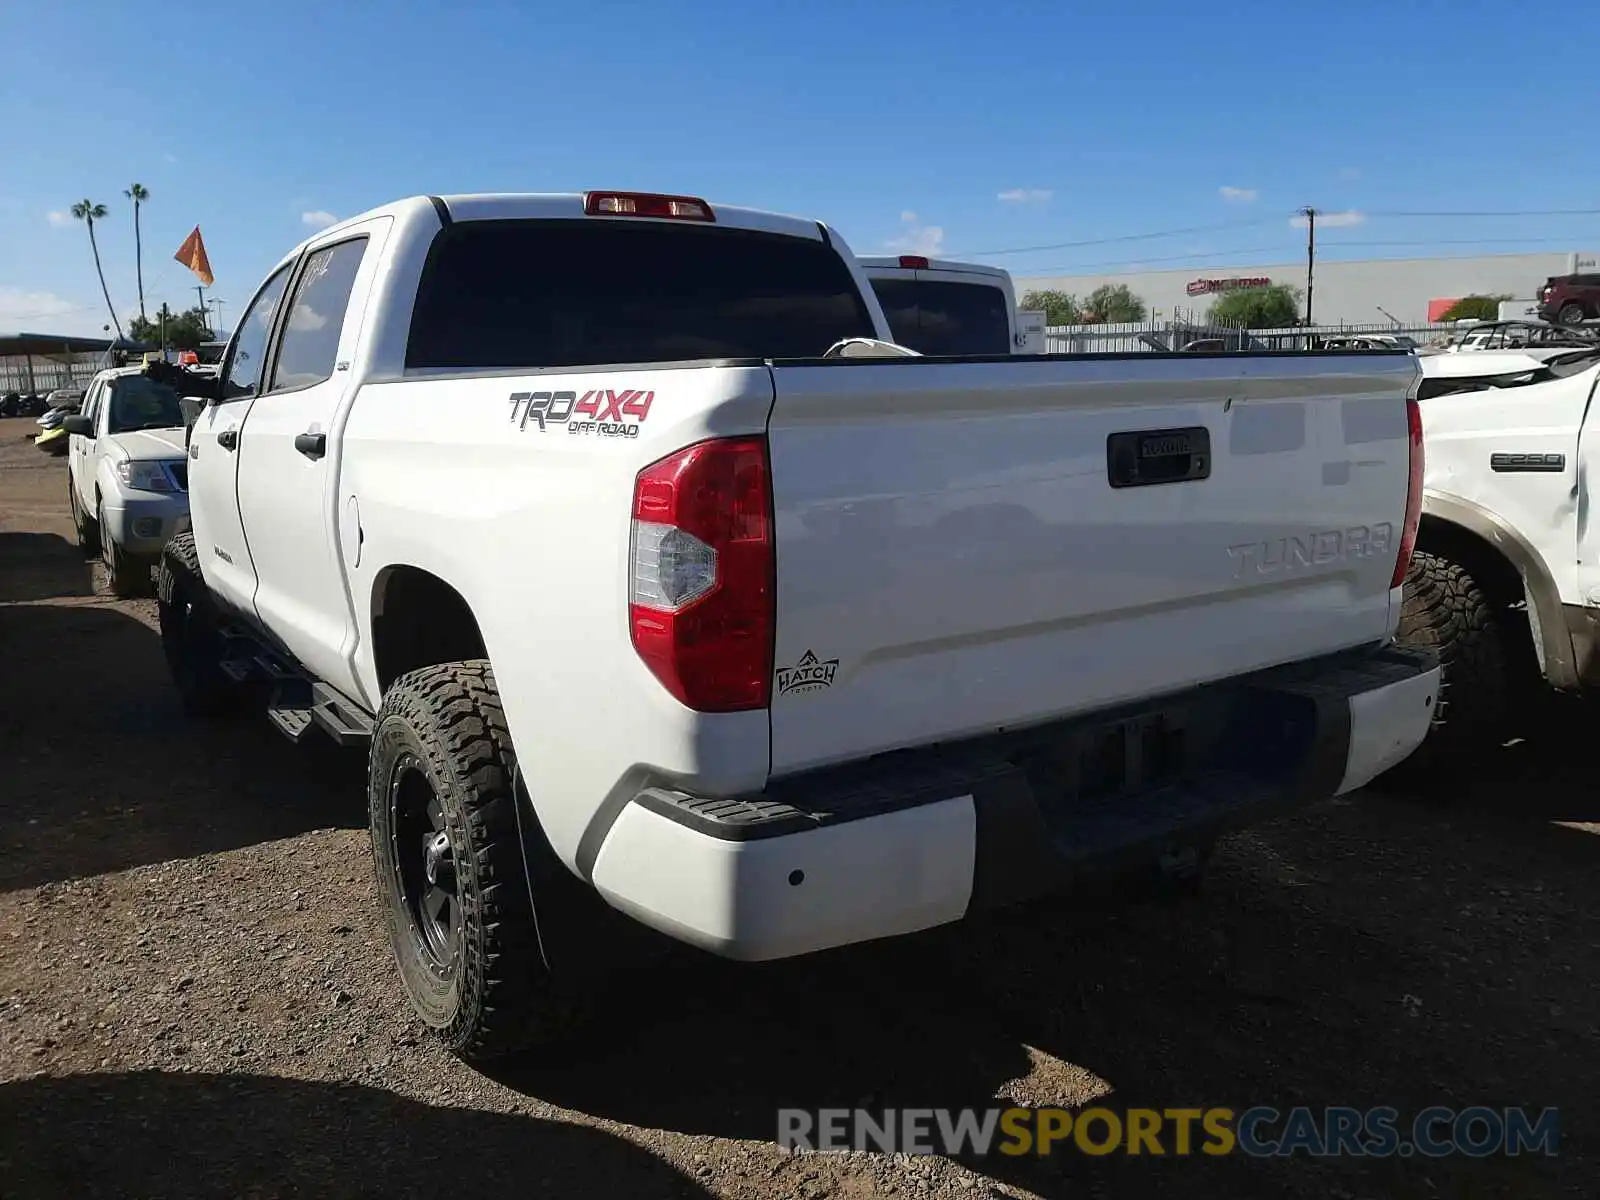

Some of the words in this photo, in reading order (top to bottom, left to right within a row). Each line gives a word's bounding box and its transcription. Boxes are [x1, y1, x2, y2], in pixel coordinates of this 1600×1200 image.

[1208, 277, 1272, 291] NUTITION
[568, 420, 597, 435] OFF
[597, 422, 640, 439] ROAD
[1226, 521, 1393, 579] TUNDRA
[778, 665, 837, 691] HATCH
